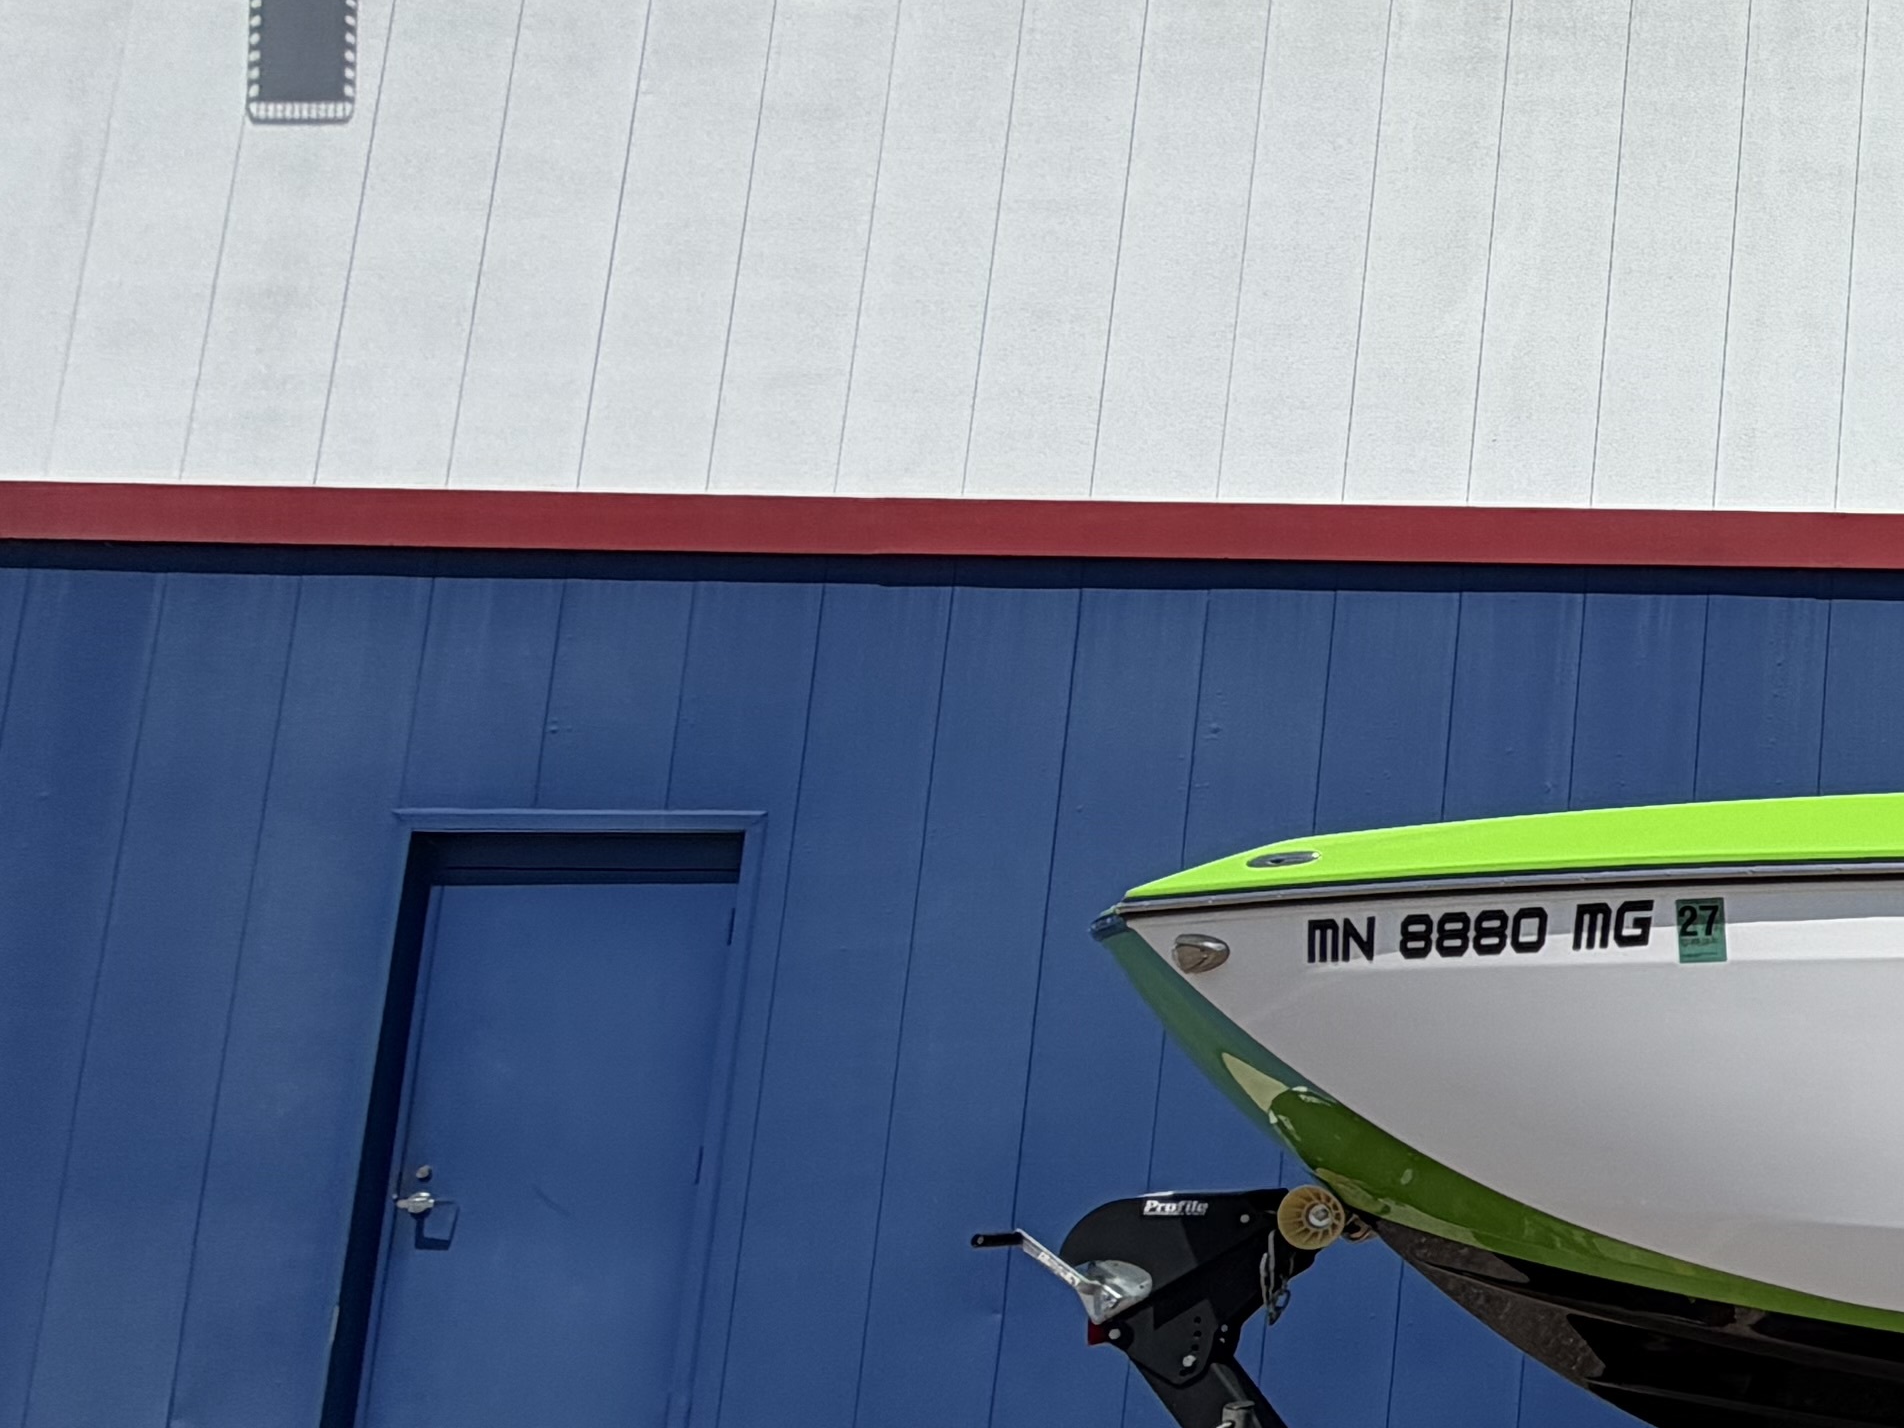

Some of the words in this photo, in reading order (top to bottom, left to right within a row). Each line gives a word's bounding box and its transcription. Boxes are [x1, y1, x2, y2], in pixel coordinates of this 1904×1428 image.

[1307, 916, 1376, 964] MN
[1399, 906, 1549, 959] 8880
[1572, 899, 1655, 950] MG
[1678, 904, 1719, 937] 27
[1143, 1199, 1209, 1213] Profile
